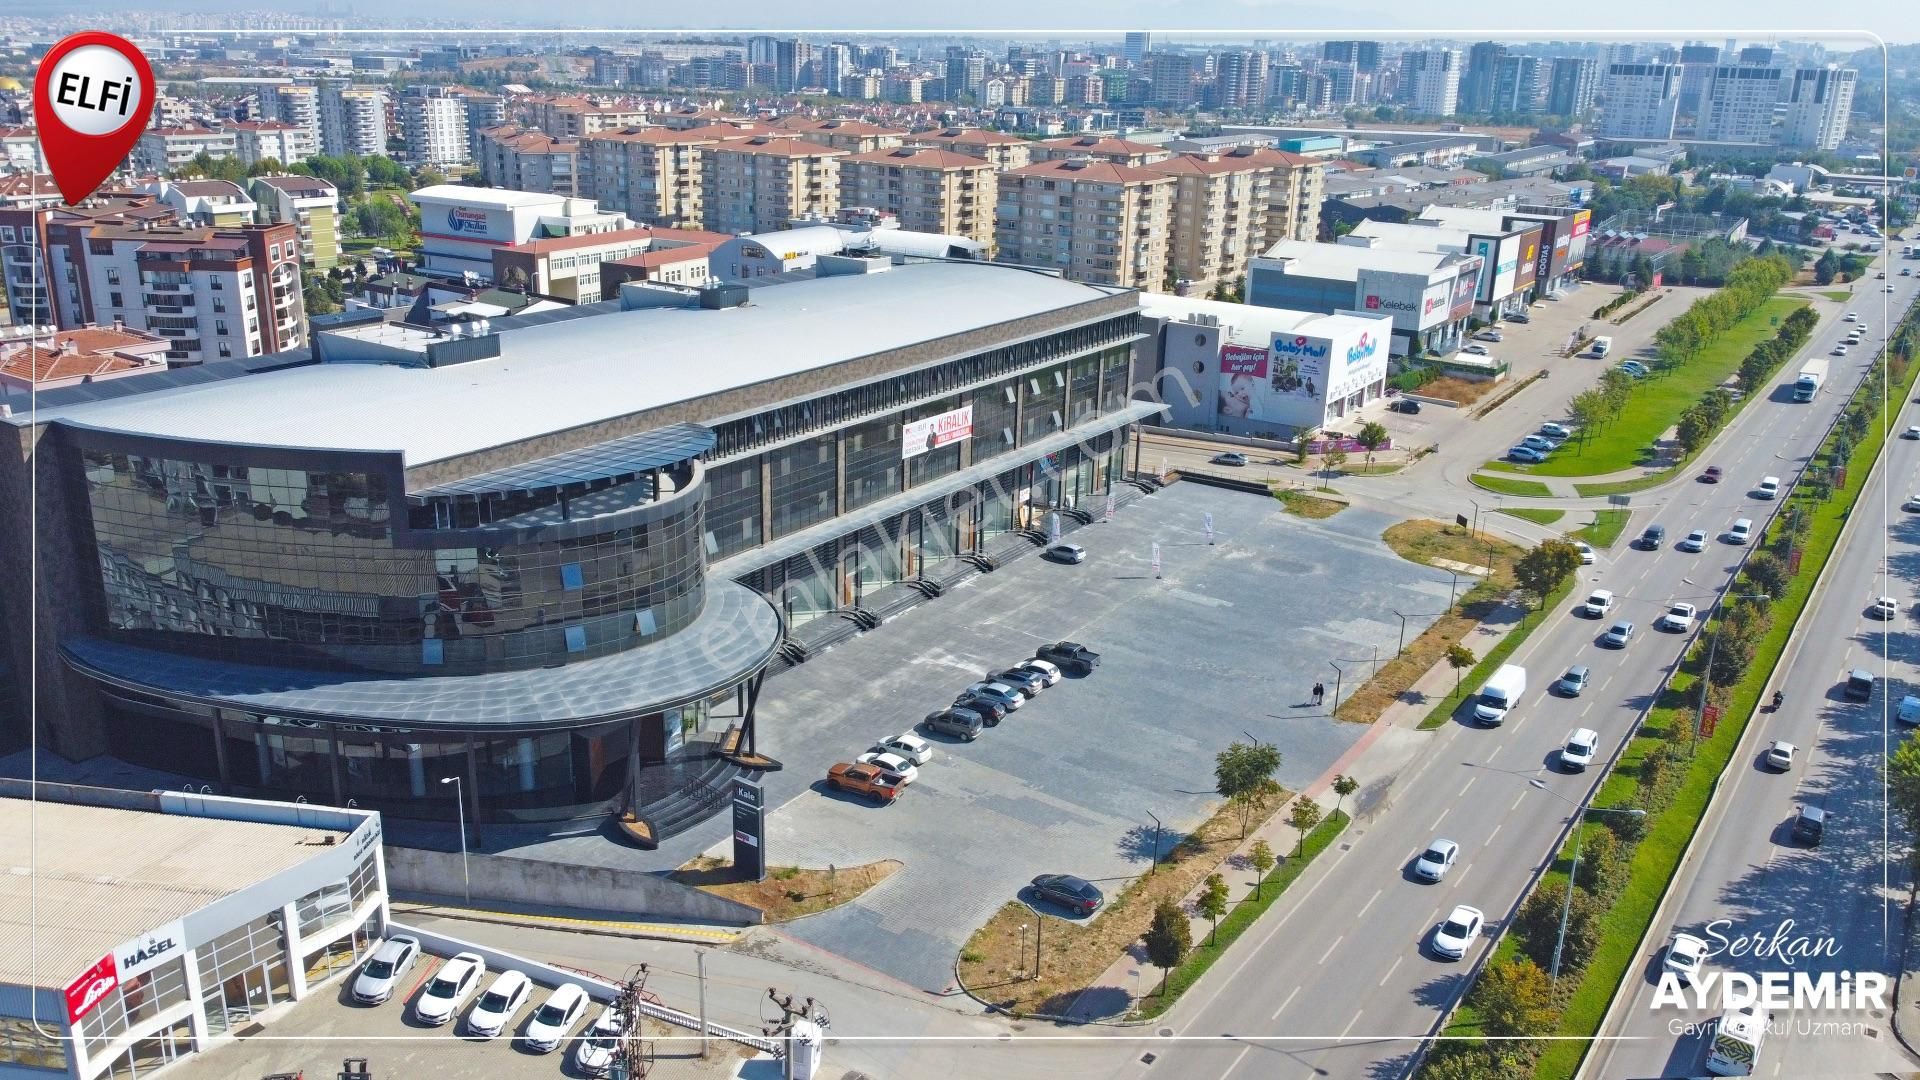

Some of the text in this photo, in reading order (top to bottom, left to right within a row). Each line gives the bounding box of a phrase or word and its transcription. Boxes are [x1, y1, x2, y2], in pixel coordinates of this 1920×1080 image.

[1380, 298, 1417, 313] Kelebek
[1275, 339, 1327, 358] Baby Mall
[738, 787, 755, 801] Kale
[124, 937, 177, 970] HASEL
